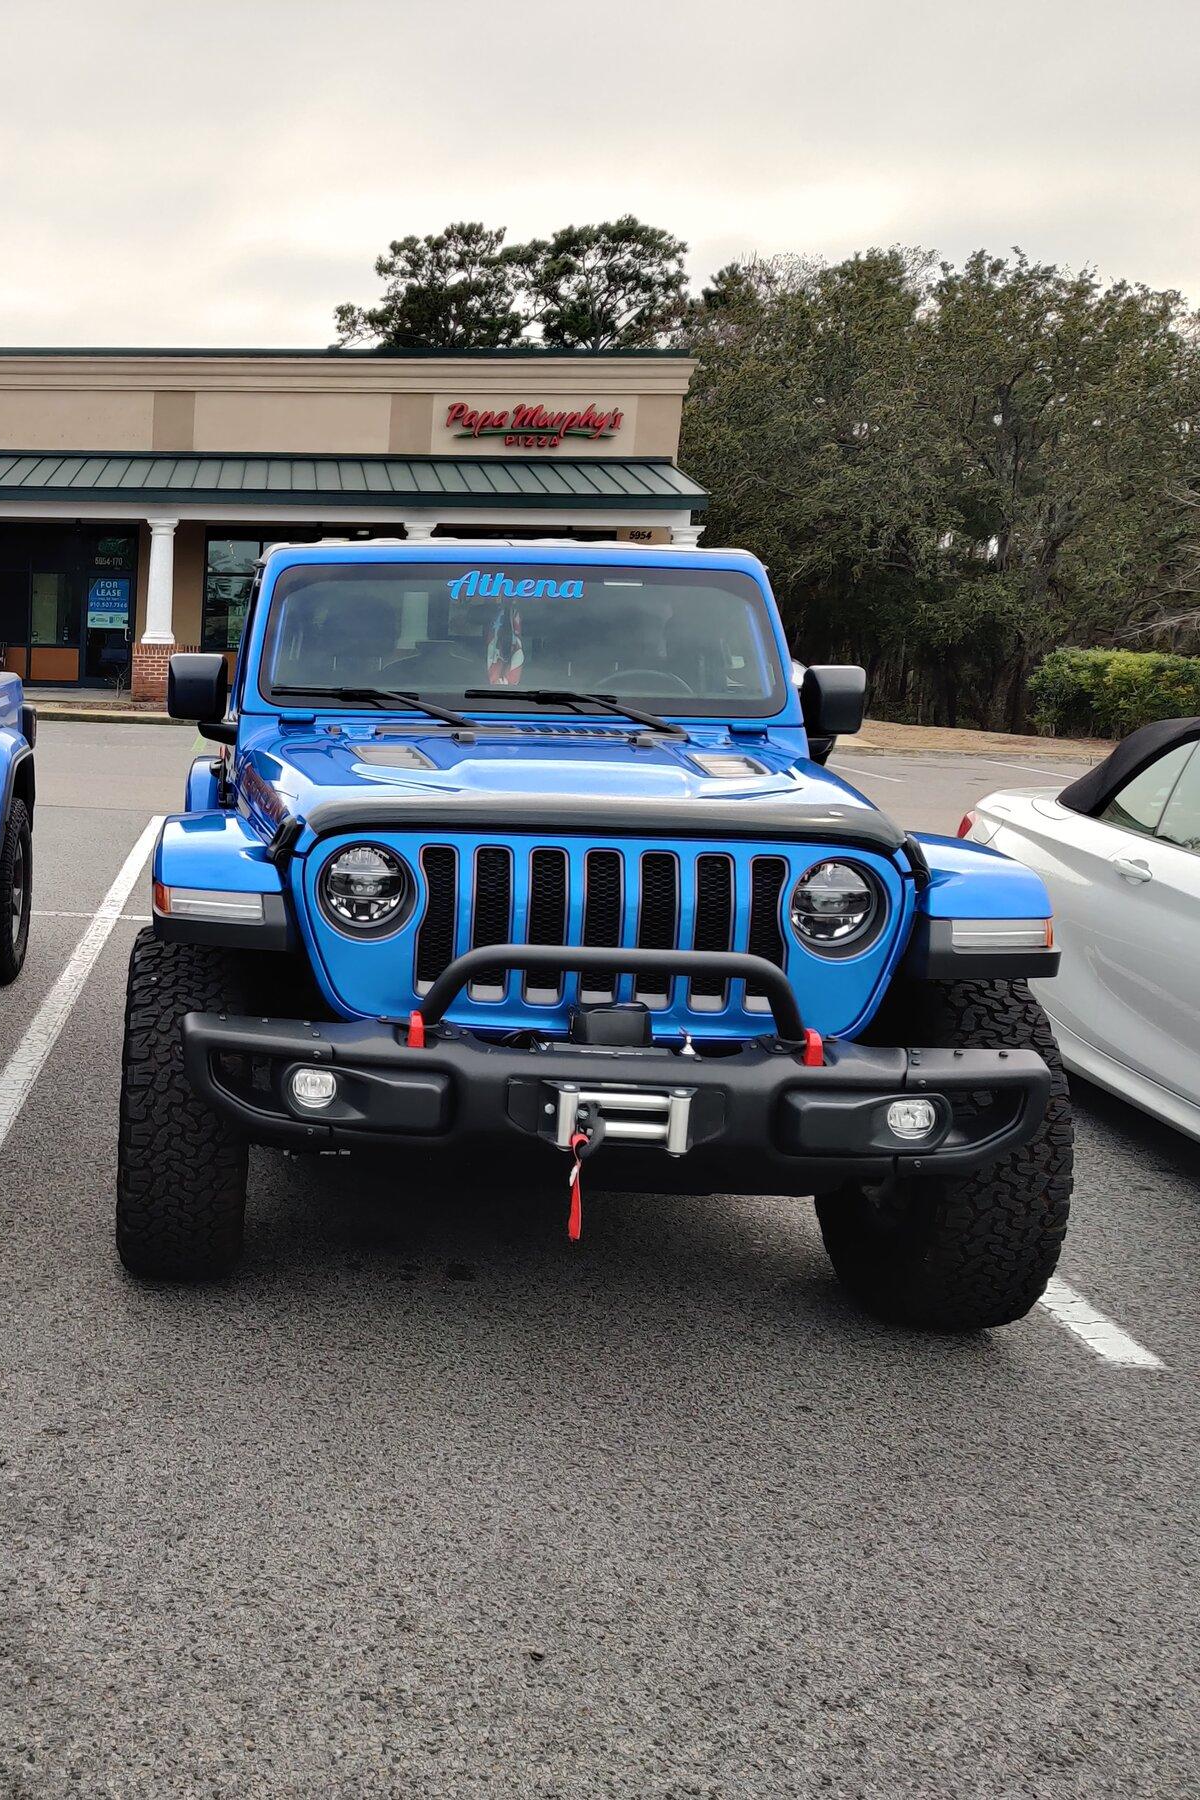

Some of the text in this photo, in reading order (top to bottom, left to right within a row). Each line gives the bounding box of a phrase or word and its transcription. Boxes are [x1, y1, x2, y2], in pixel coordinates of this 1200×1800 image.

[446, 402, 624, 439] Papa Murphy's
[505, 435, 559, 447] PIZZA
[629, 530, 652, 540] 5954
[447, 570, 584, 600] Athena
[96, 589, 122, 597] LEASE
